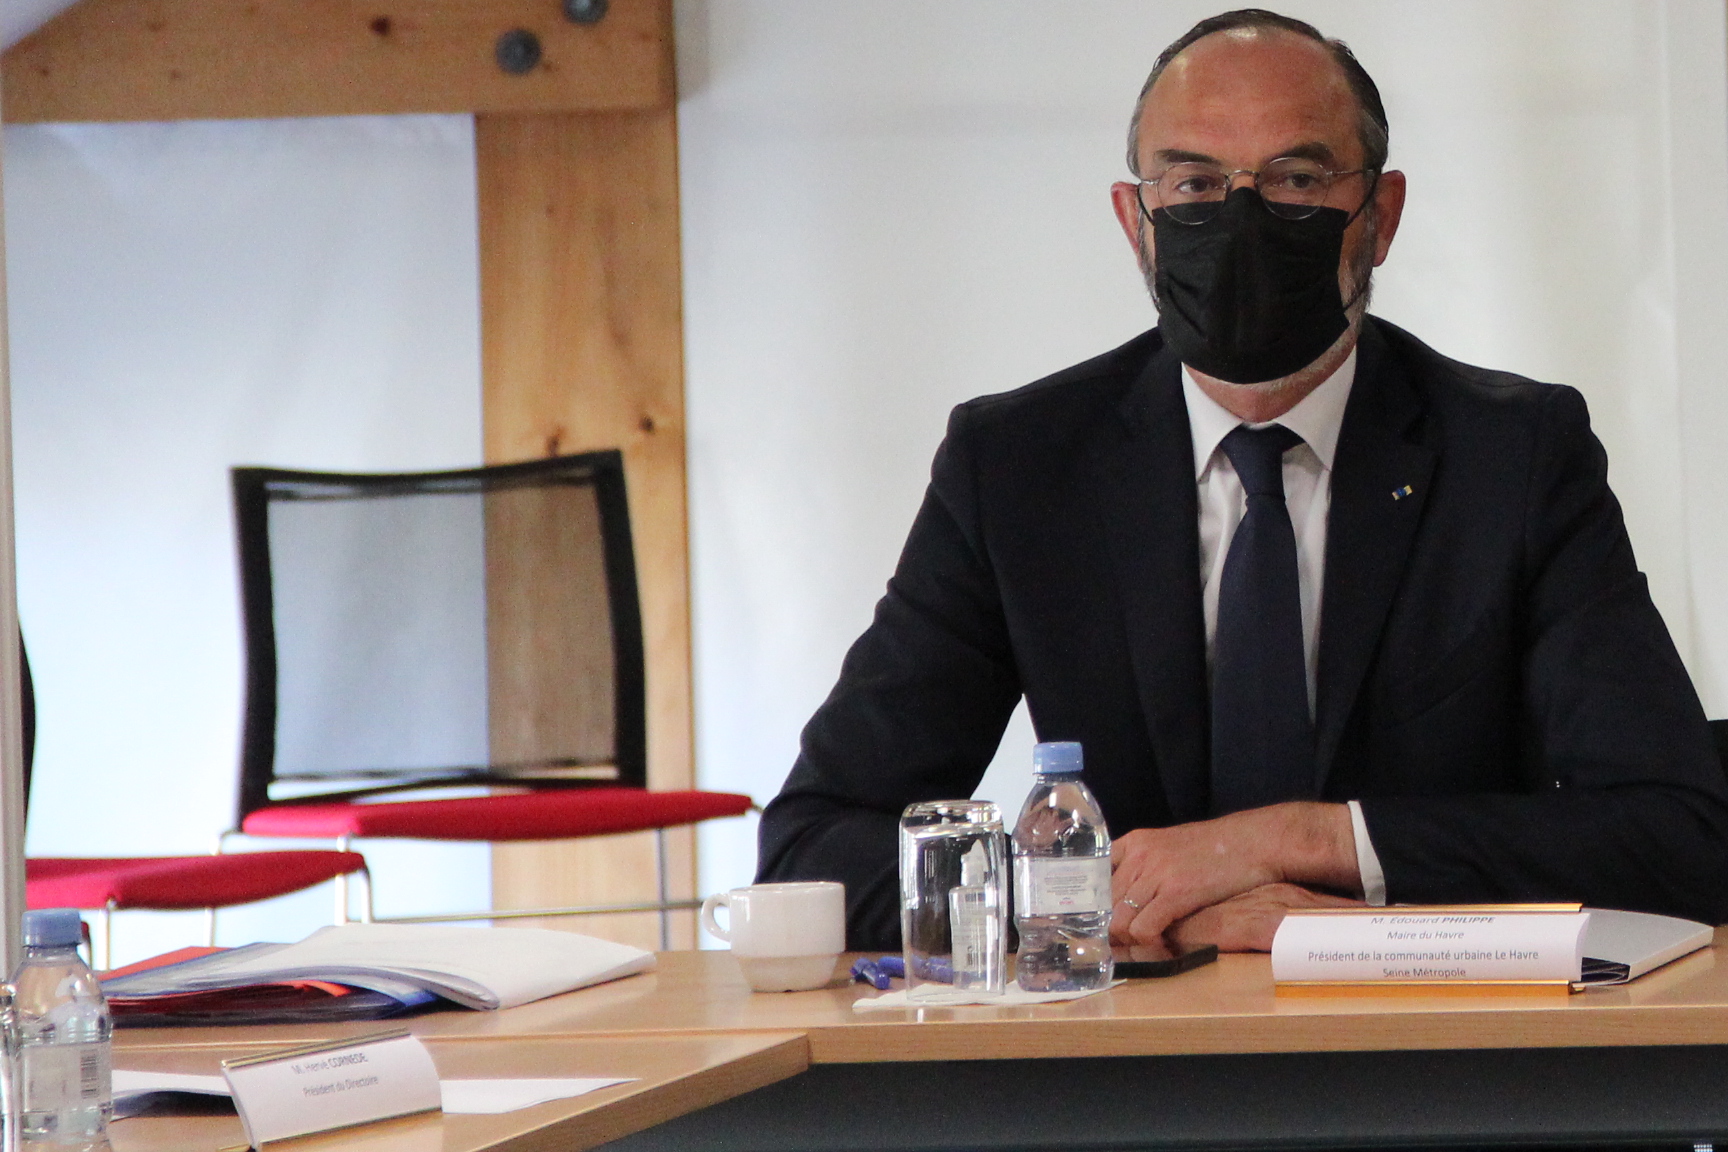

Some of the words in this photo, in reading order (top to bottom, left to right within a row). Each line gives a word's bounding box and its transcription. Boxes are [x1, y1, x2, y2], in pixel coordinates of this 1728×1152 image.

[1370, 917, 1385, 925] M.
[1441, 916, 1496, 924] PHILIPPE
[1386, 930, 1417, 940] Maire
[1419, 930, 1433, 940] du
[1434, 930, 1464, 940] Havre
[1308, 950, 1355, 962] Président
[1357, 950, 1371, 962] de
[1372, 950, 1382, 962] la
[1384, 950, 1451, 961] communauté
[1453, 949, 1493, 961] urbaine
[1495, 950, 1507, 960] Le
[1509, 950, 1539, 960] Havre
[1383, 967, 1411, 978] Seine
[1412, 967, 1466, 980] Métropole
